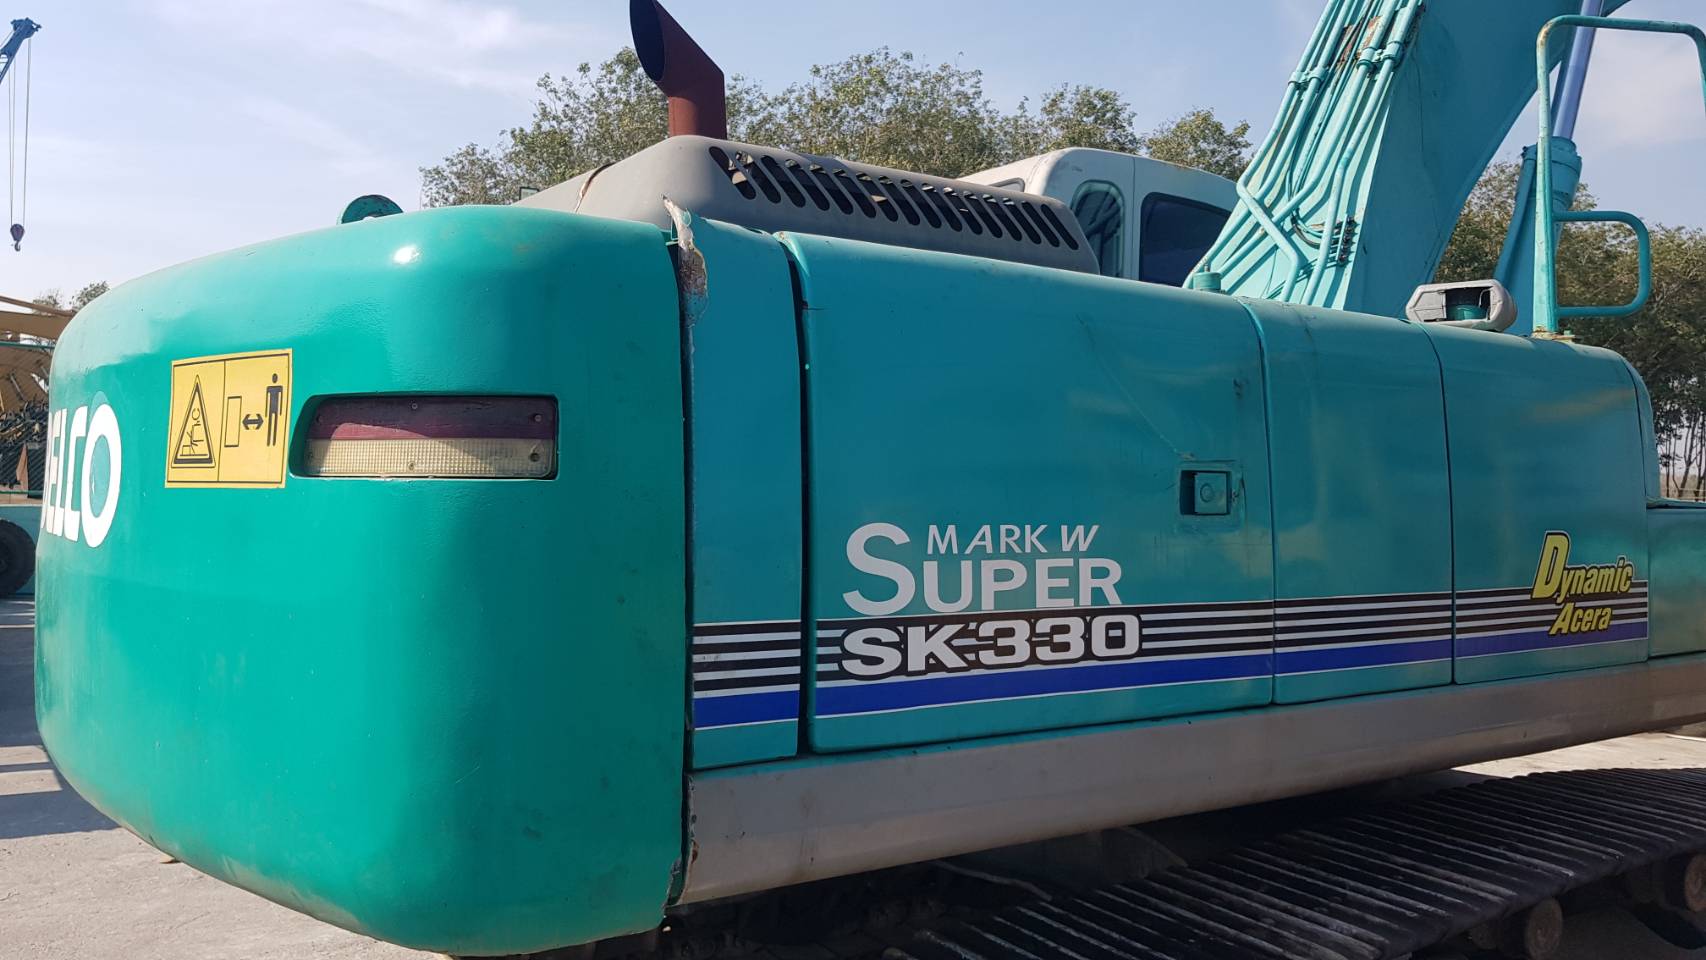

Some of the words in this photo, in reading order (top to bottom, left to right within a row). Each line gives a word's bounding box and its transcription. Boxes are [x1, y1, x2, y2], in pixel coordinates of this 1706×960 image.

[40, 403, 122, 548] ELCO
[842, 522, 1123, 616] SUPER
[927, 524, 1048, 555] MARK
[1060, 524, 1100, 552] W
[1531, 532, 1633, 604] Dynamic
[842, 614, 1140, 676] SK330
[1548, 602, 1612, 635] Acera
